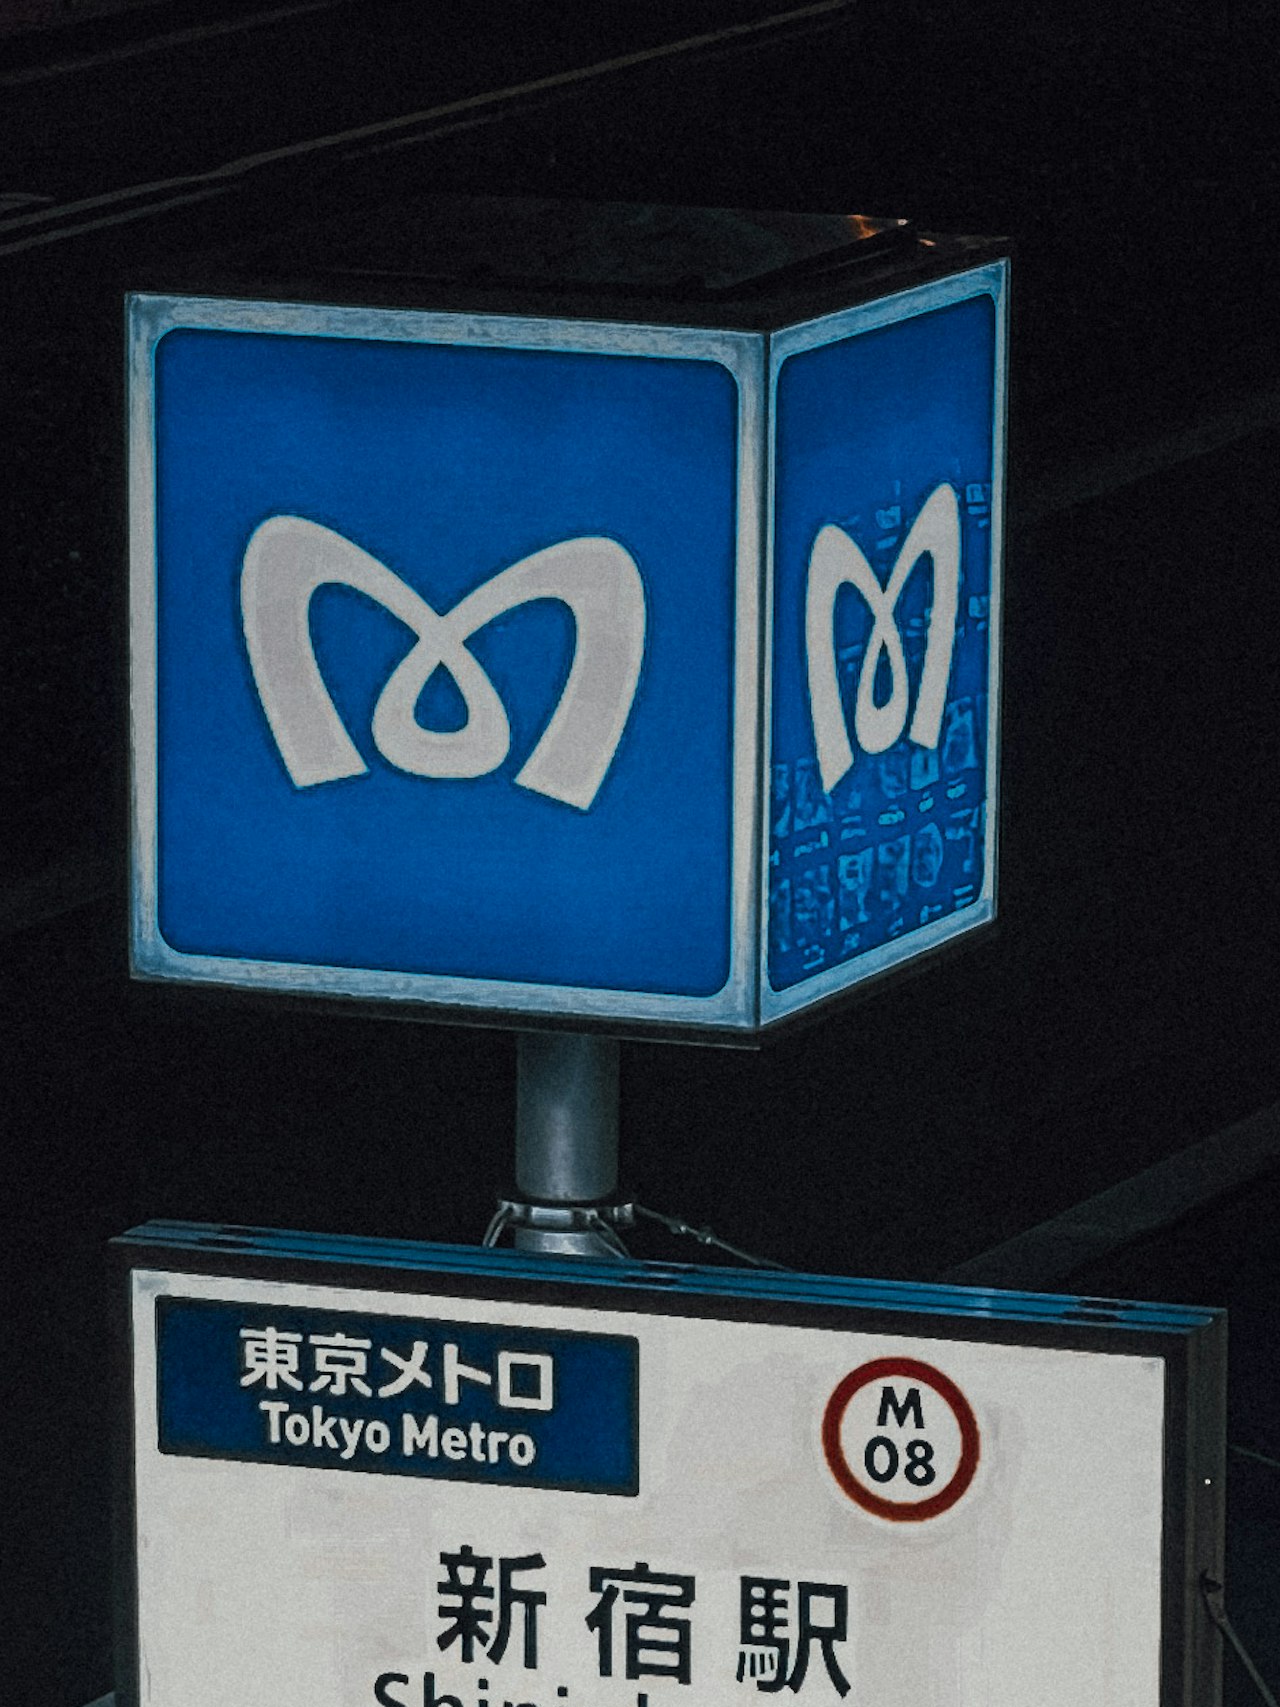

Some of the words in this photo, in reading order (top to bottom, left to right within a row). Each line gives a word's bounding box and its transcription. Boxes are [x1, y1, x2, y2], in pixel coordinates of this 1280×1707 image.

[239, 1326, 555, 1411] 東京メトロ
[258, 1400, 391, 1460] Tokyo
[402, 1412, 536, 1467] Metro
[876, 1385, 925, 1429] M
[864, 1434, 936, 1487] 08
[436, 1544, 853, 1699] 新宿駅
